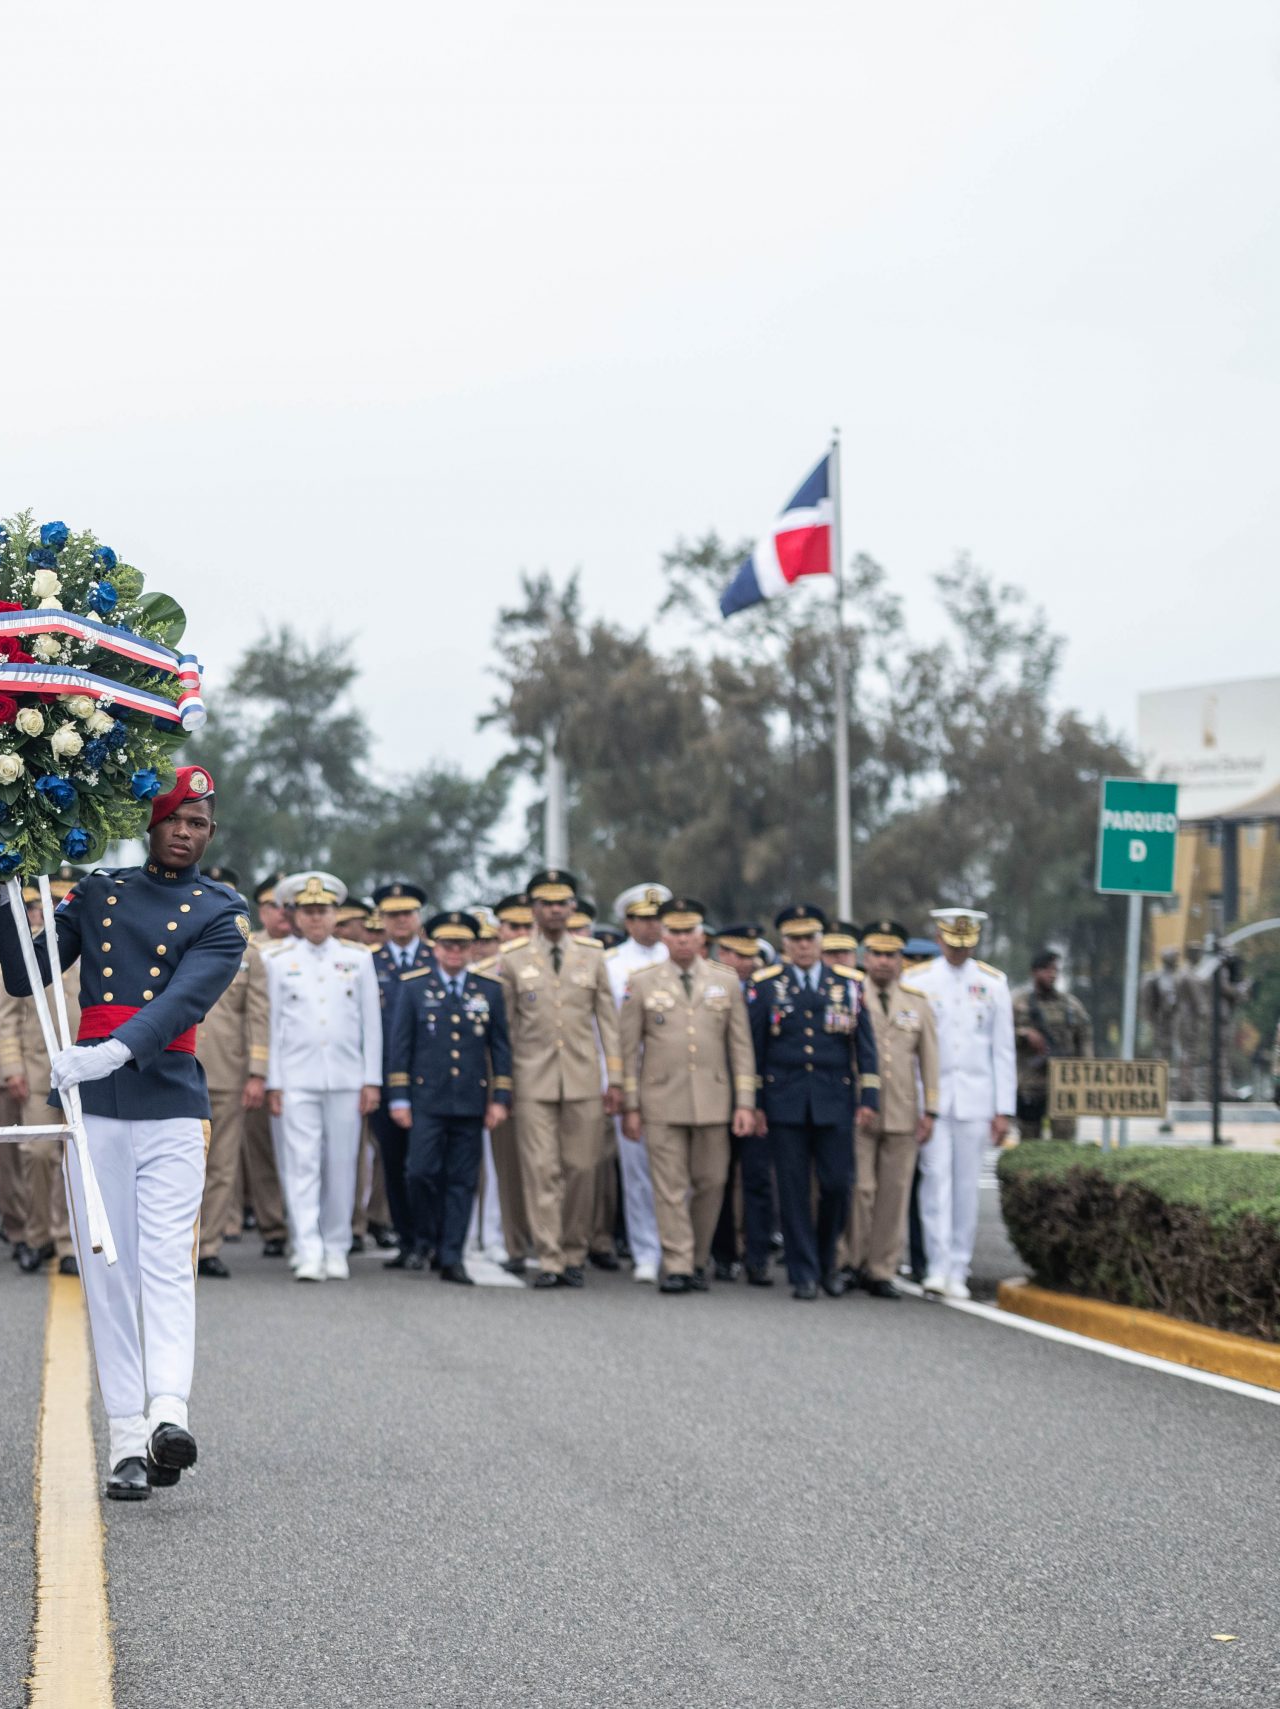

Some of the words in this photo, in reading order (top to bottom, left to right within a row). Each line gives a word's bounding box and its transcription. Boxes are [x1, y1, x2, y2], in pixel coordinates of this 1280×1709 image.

[14, 664, 92, 688] Defensa
[1102, 809, 1177, 833] PARQUEO
[1129, 839, 1147, 862] D
[1060, 1063, 1156, 1086] ESTACIONE
[1057, 1089, 1077, 1110] EN
[1086, 1089, 1161, 1111] REVERSA
